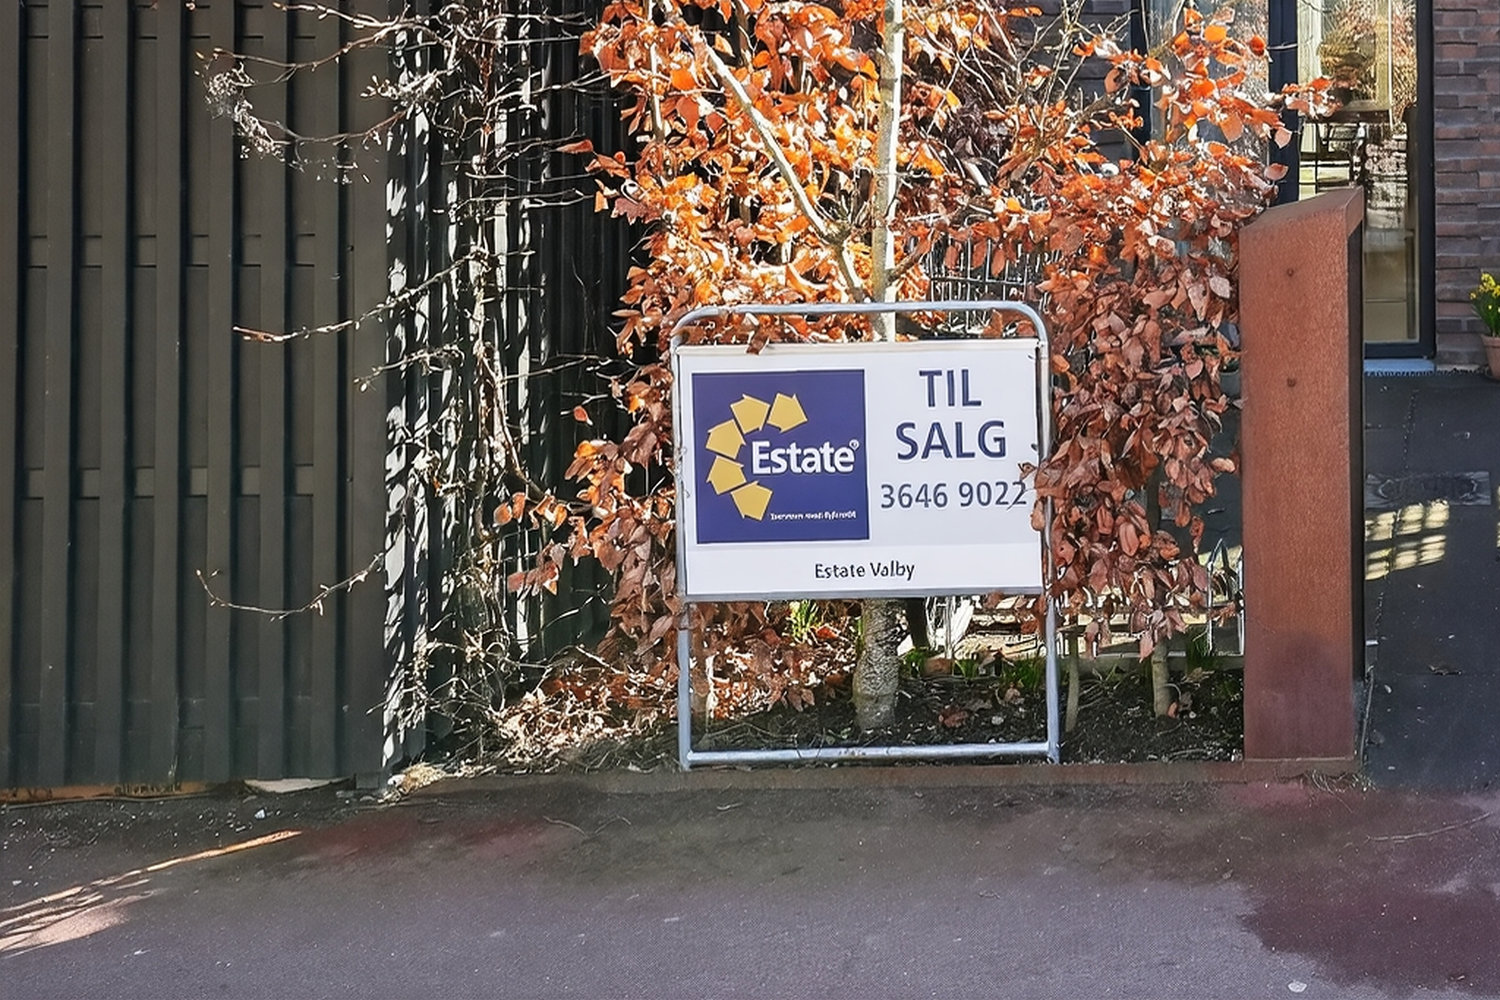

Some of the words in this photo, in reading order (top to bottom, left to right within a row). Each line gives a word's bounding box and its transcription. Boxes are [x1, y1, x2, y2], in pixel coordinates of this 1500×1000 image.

[919, 369, 982, 408] TIL
[895, 420, 1007, 461] SALG
[880, 483, 948, 508] 3646
[958, 481, 1027, 507] 9022
[815, 563, 866, 579] Estate
[869, 560, 915, 581] Valby
